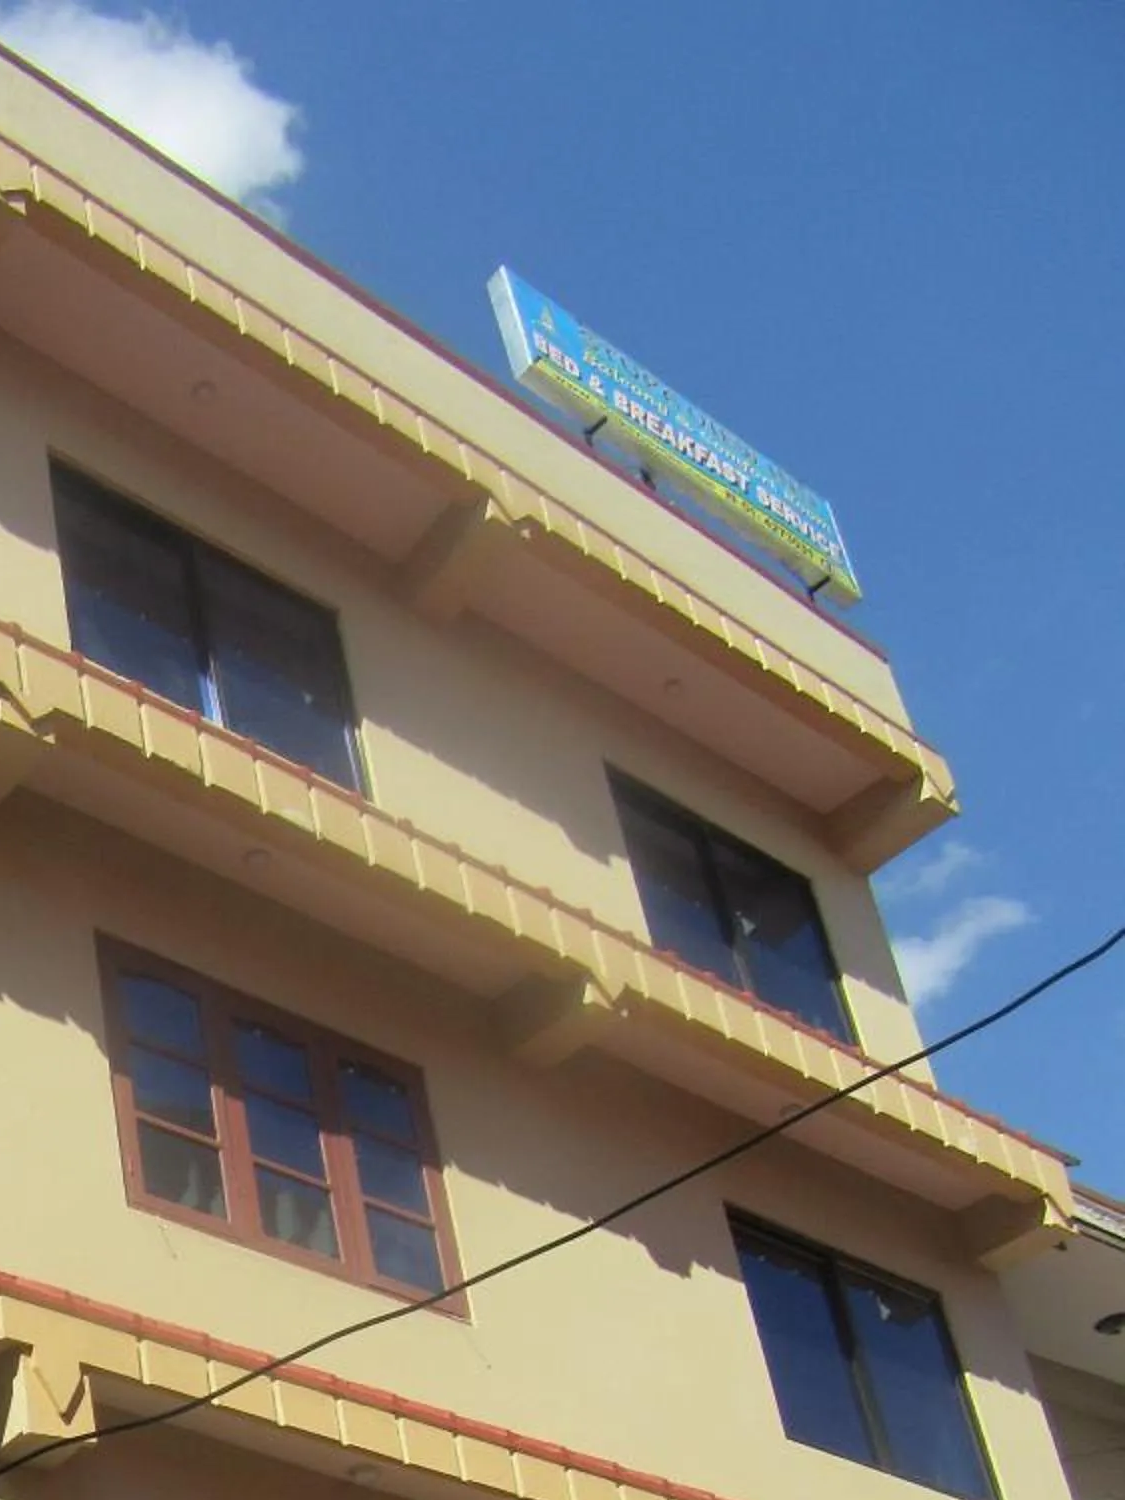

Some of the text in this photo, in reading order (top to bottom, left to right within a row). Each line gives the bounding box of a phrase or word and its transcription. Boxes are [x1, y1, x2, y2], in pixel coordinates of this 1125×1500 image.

[533, 331, 581, 380] BED
[588, 373, 606, 397] &
[613, 388, 748, 495] BREAKFAST
[756, 484, 845, 564] SERVICE
